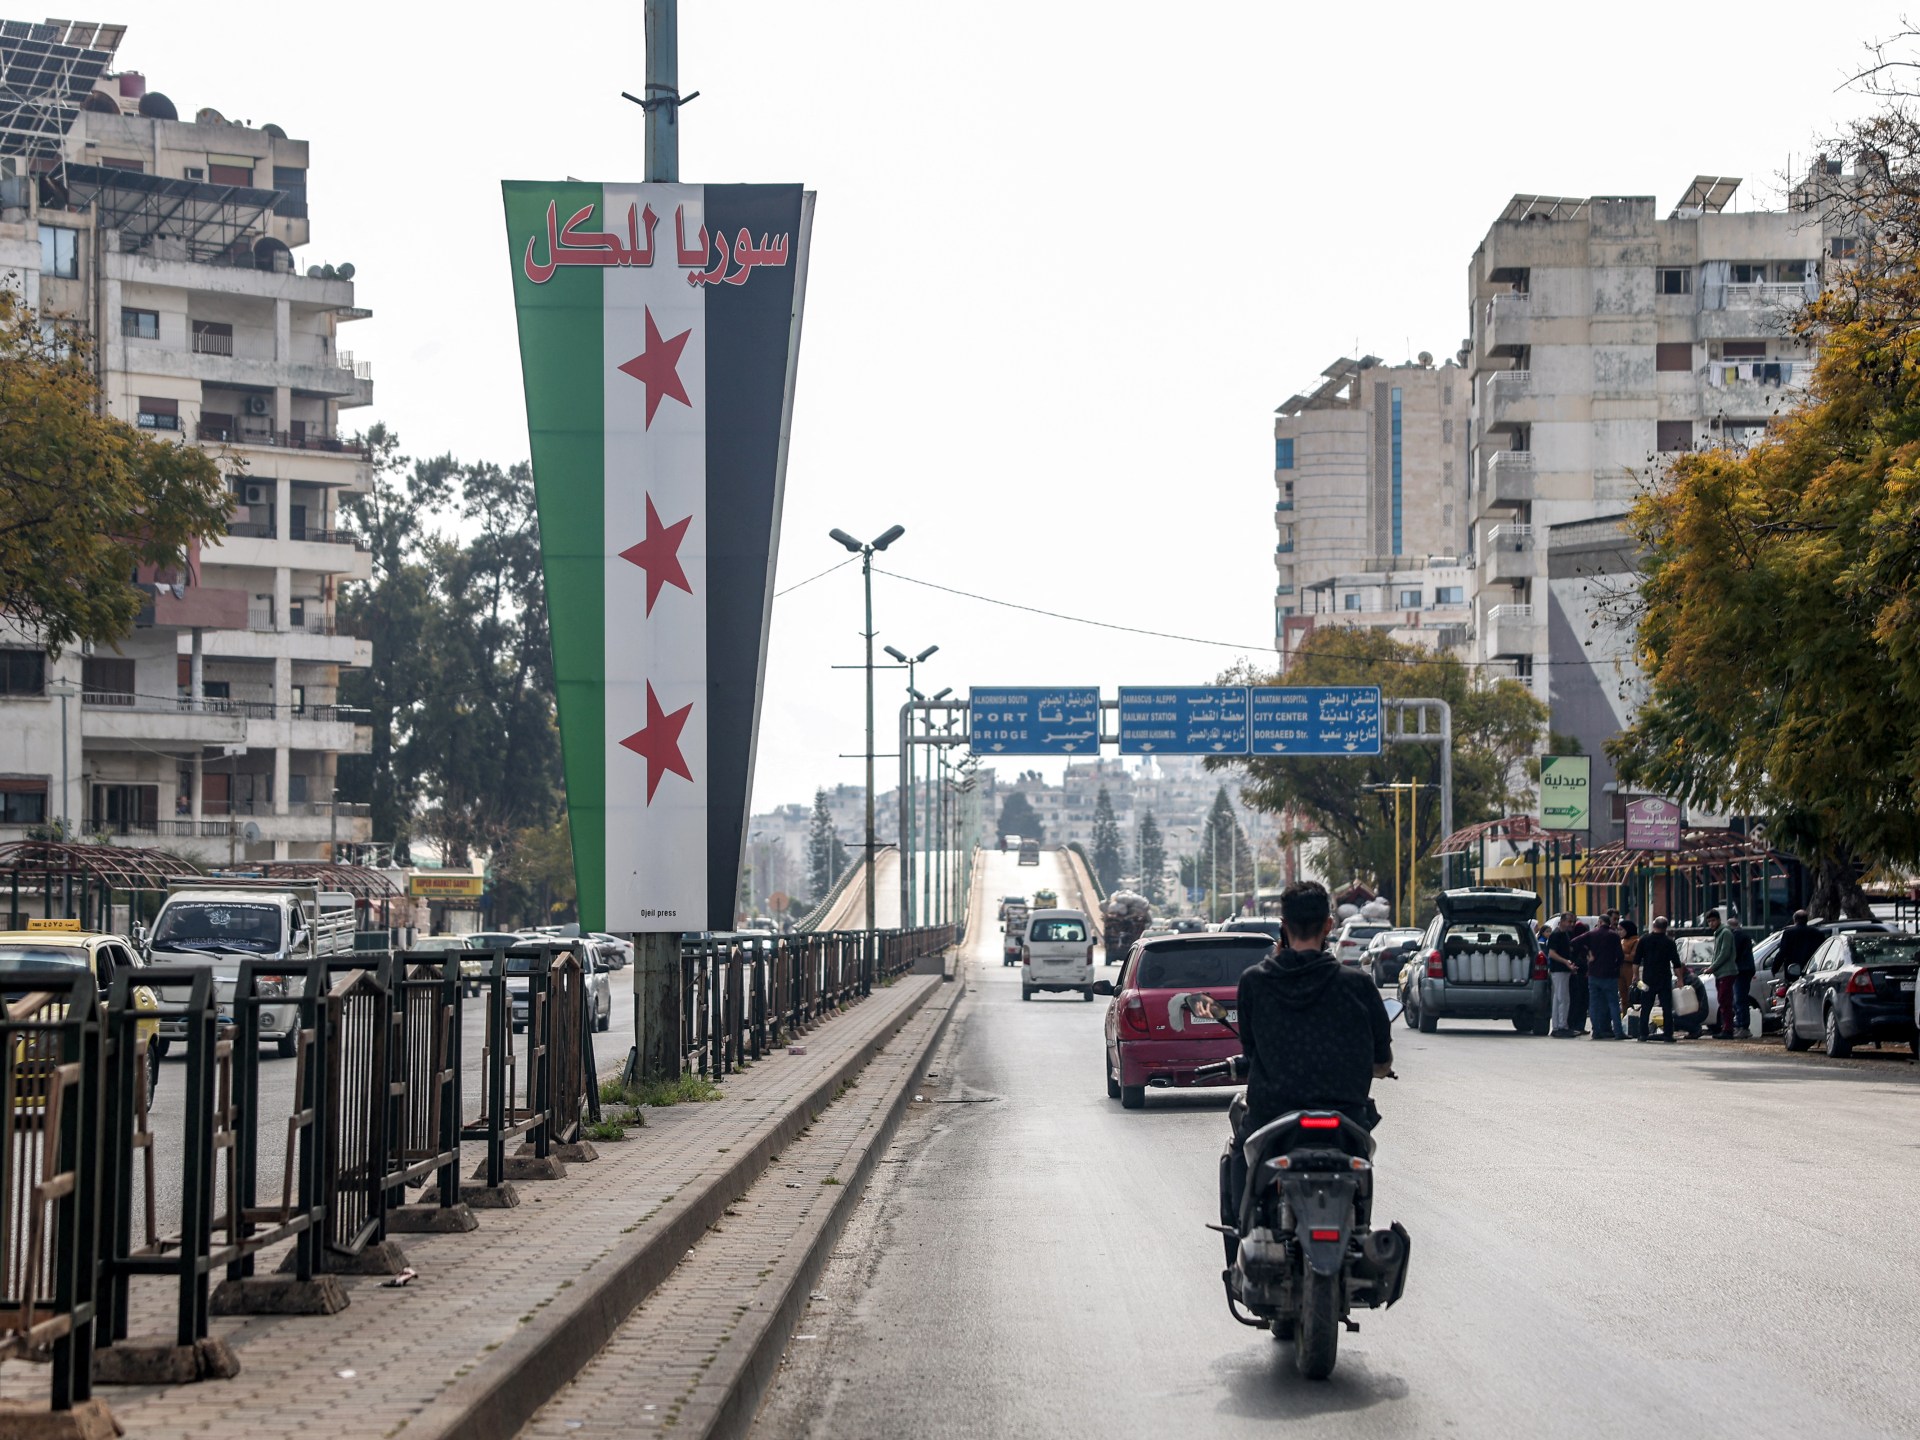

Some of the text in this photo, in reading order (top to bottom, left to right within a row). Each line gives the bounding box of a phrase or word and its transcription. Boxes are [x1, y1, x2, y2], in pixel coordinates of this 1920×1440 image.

[523, 198, 791, 287] سوريا للكل
[1008, 696, 1028, 704] SOUTH
[1122, 695, 1151, 704] DAMASCUS
[1156, 694, 1177, 704] ALEPPO
[1187, 694, 1214, 707] حلب
[1220, 691, 1244, 706] دمشق
[1282, 695, 1308, 704] HOSPITAL
[973, 713, 1028, 722] PORT
[1122, 712, 1177, 721] RAILWAY STATION
[1188, 709, 1244, 725] محطة القطار
[1254, 712, 1308, 721] CITY CENTER
[973, 730, 1028, 739] BRIDGE
[1041, 731, 1095, 743] جسر
[1254, 730, 1308, 740] BORSAEED Str.
[1344, 730, 1359, 742] بور
[1359, 726, 1377, 742] شارع
[1544, 774, 1587, 789] صيدلية
[1630, 809, 1678, 830] صيدلية
[416, 879, 432, 888] SUPER
[433, 879, 452, 888] MARKET
[657, 910, 677, 918] press
